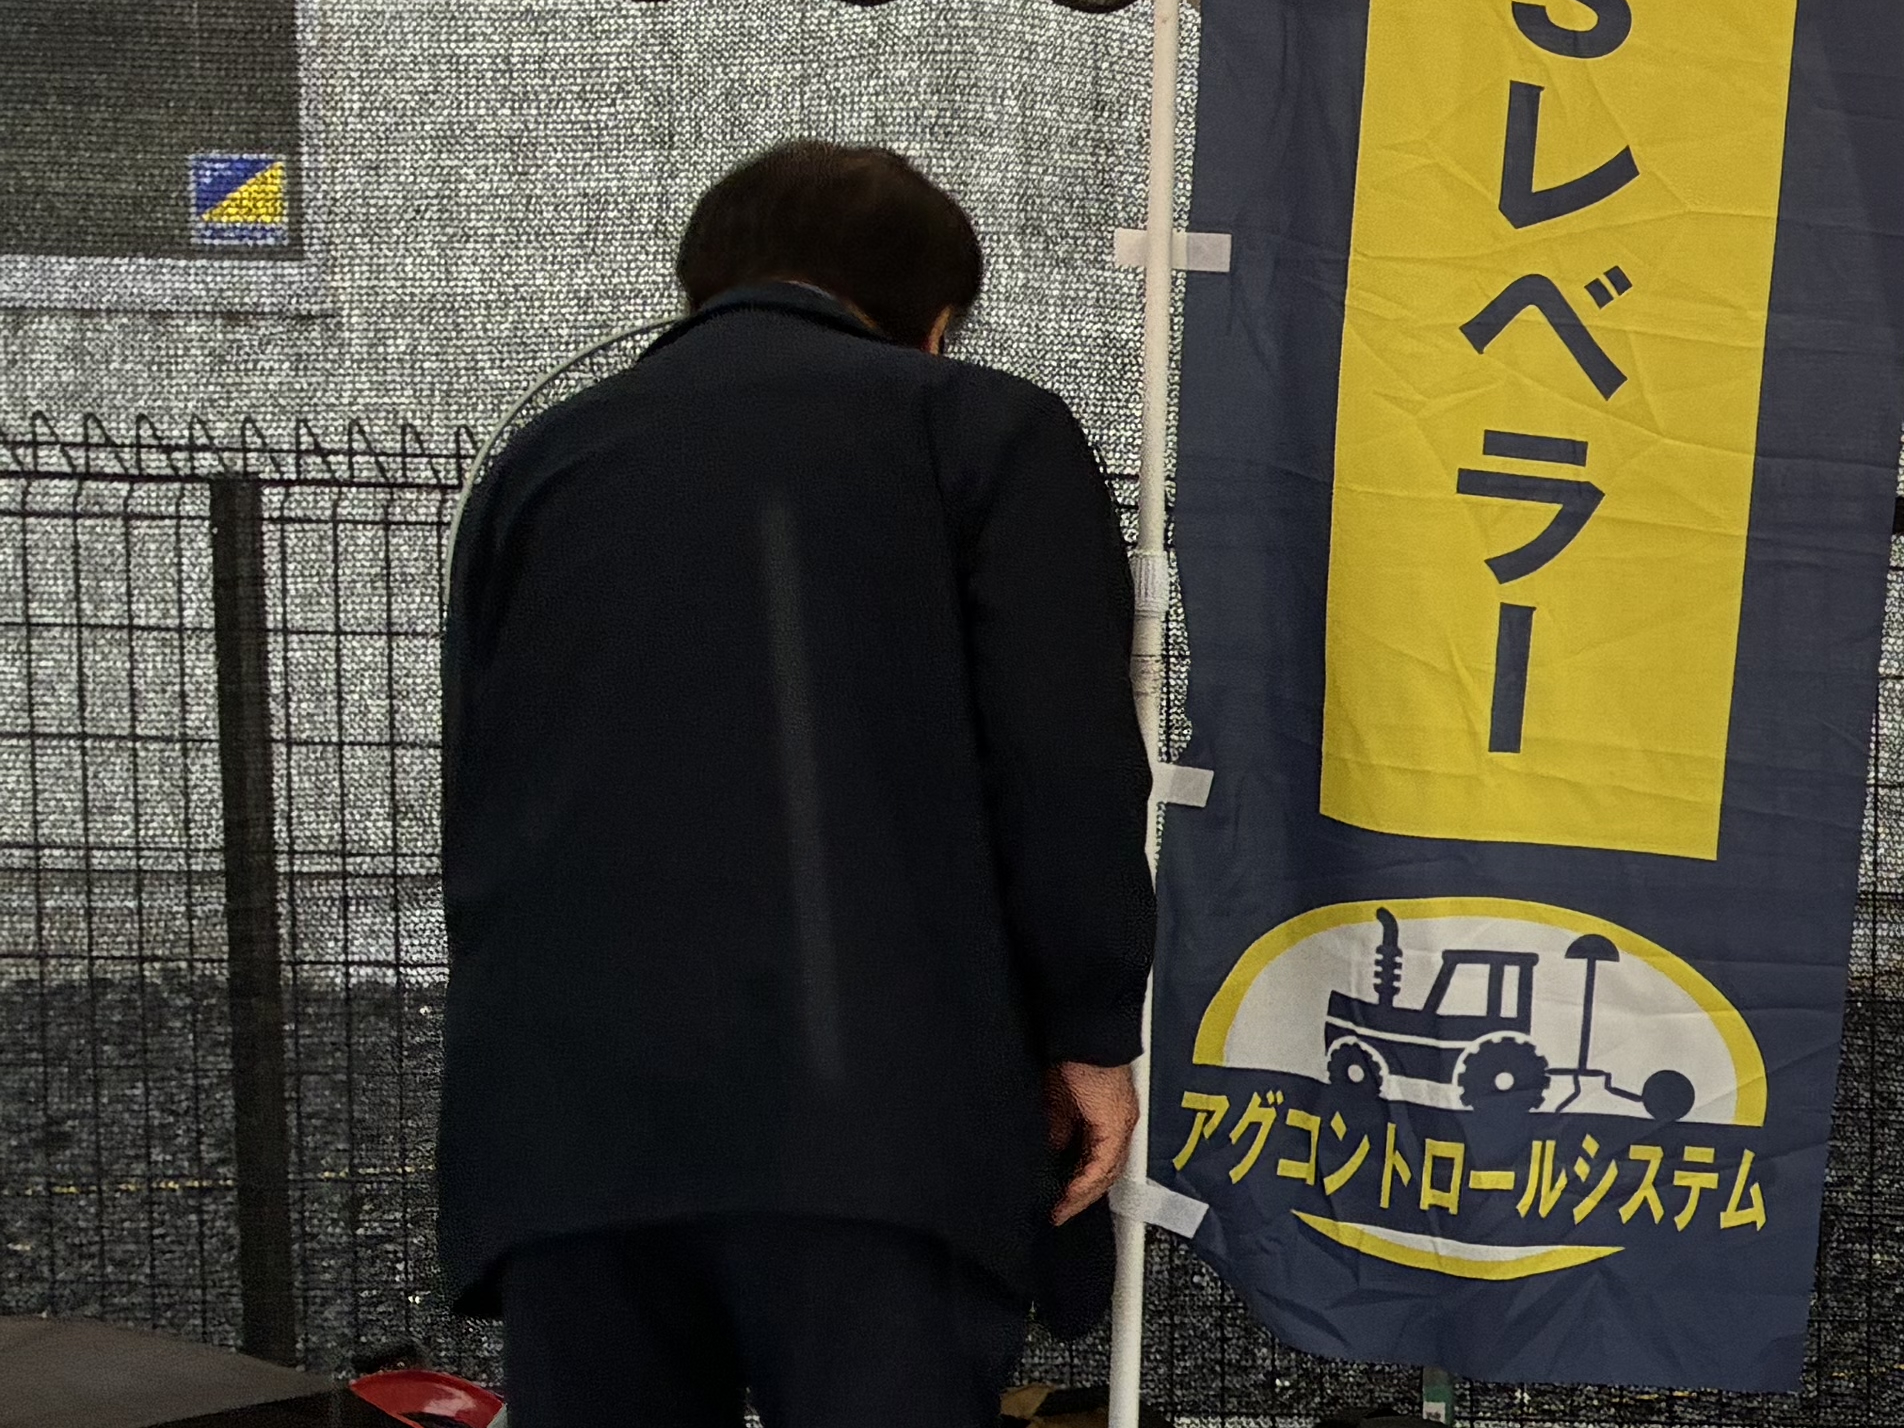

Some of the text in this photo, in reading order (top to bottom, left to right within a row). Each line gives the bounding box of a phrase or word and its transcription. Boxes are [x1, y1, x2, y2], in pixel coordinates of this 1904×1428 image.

[1171, 1088, 1768, 1233] アグコントロールシステム
